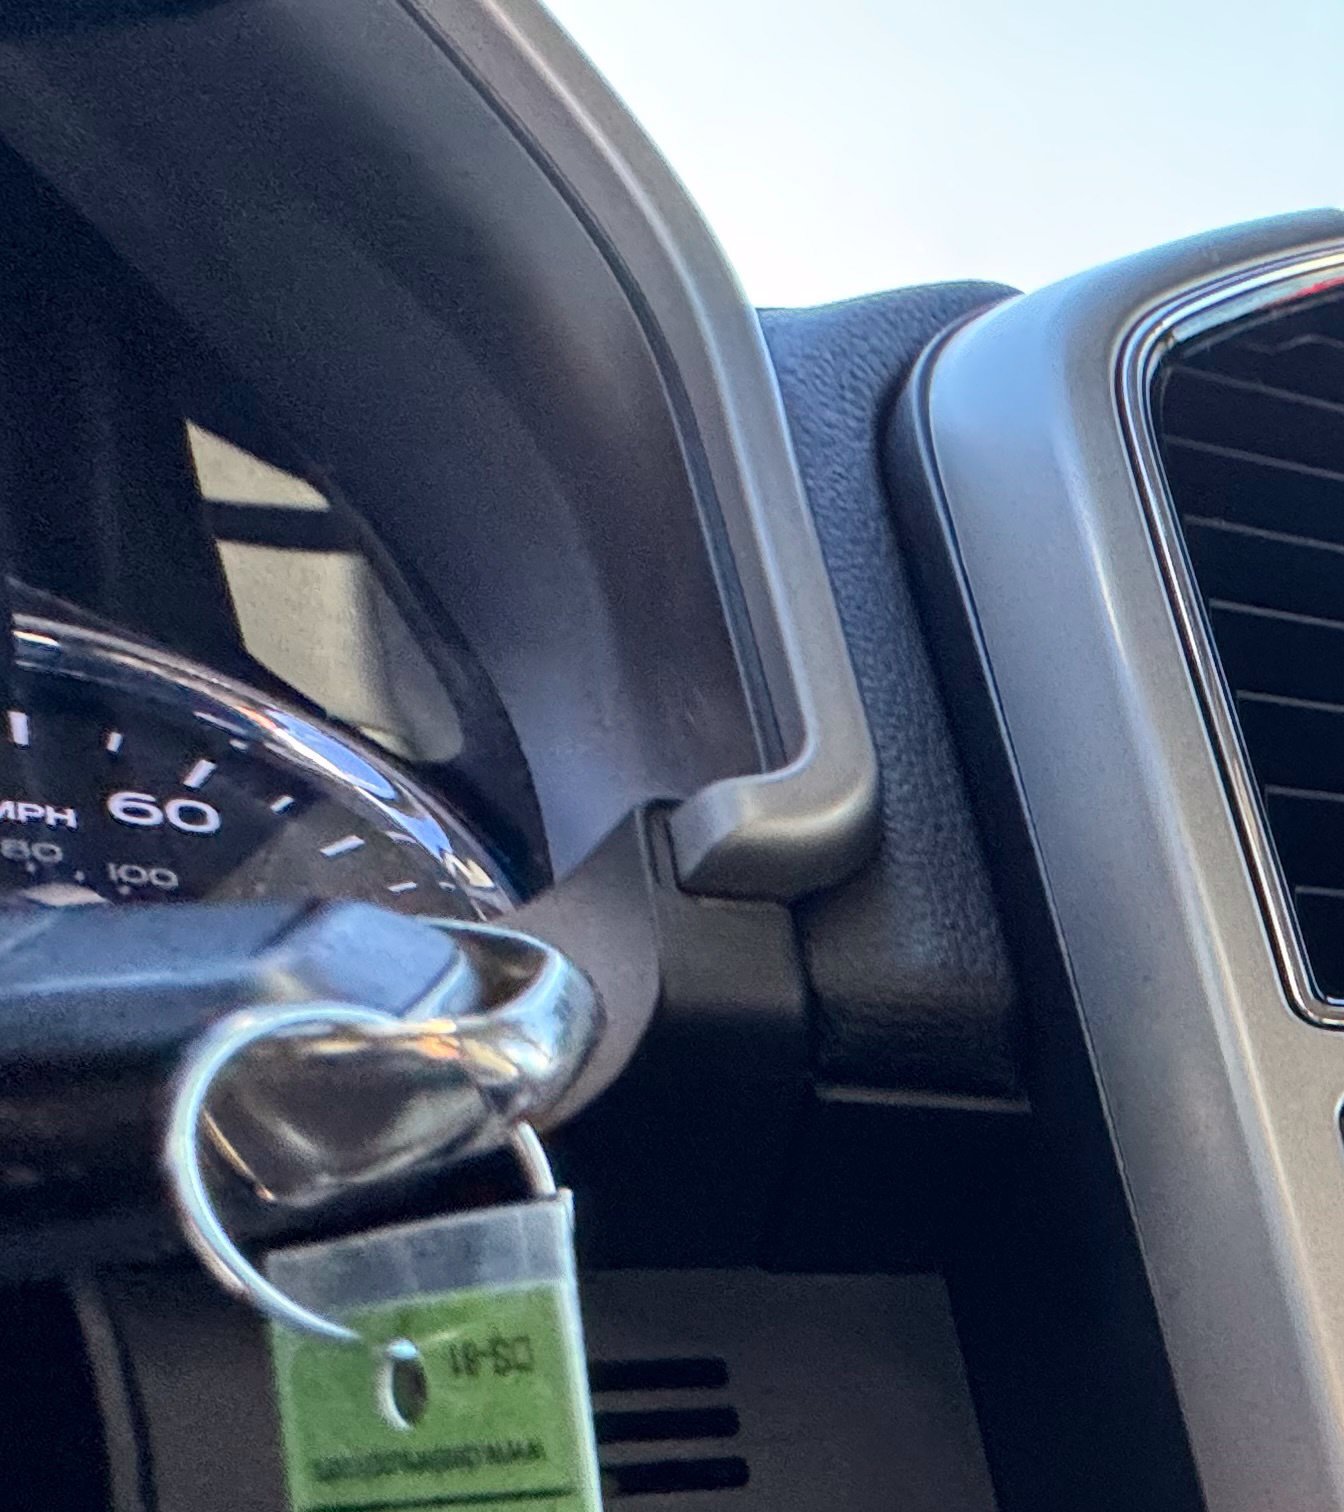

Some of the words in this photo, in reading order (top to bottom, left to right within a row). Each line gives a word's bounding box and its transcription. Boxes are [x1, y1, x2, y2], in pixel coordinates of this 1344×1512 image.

[107, 791, 221, 834] 60
[0, 839, 63, 863] 80
[108, 863, 179, 890] 100
